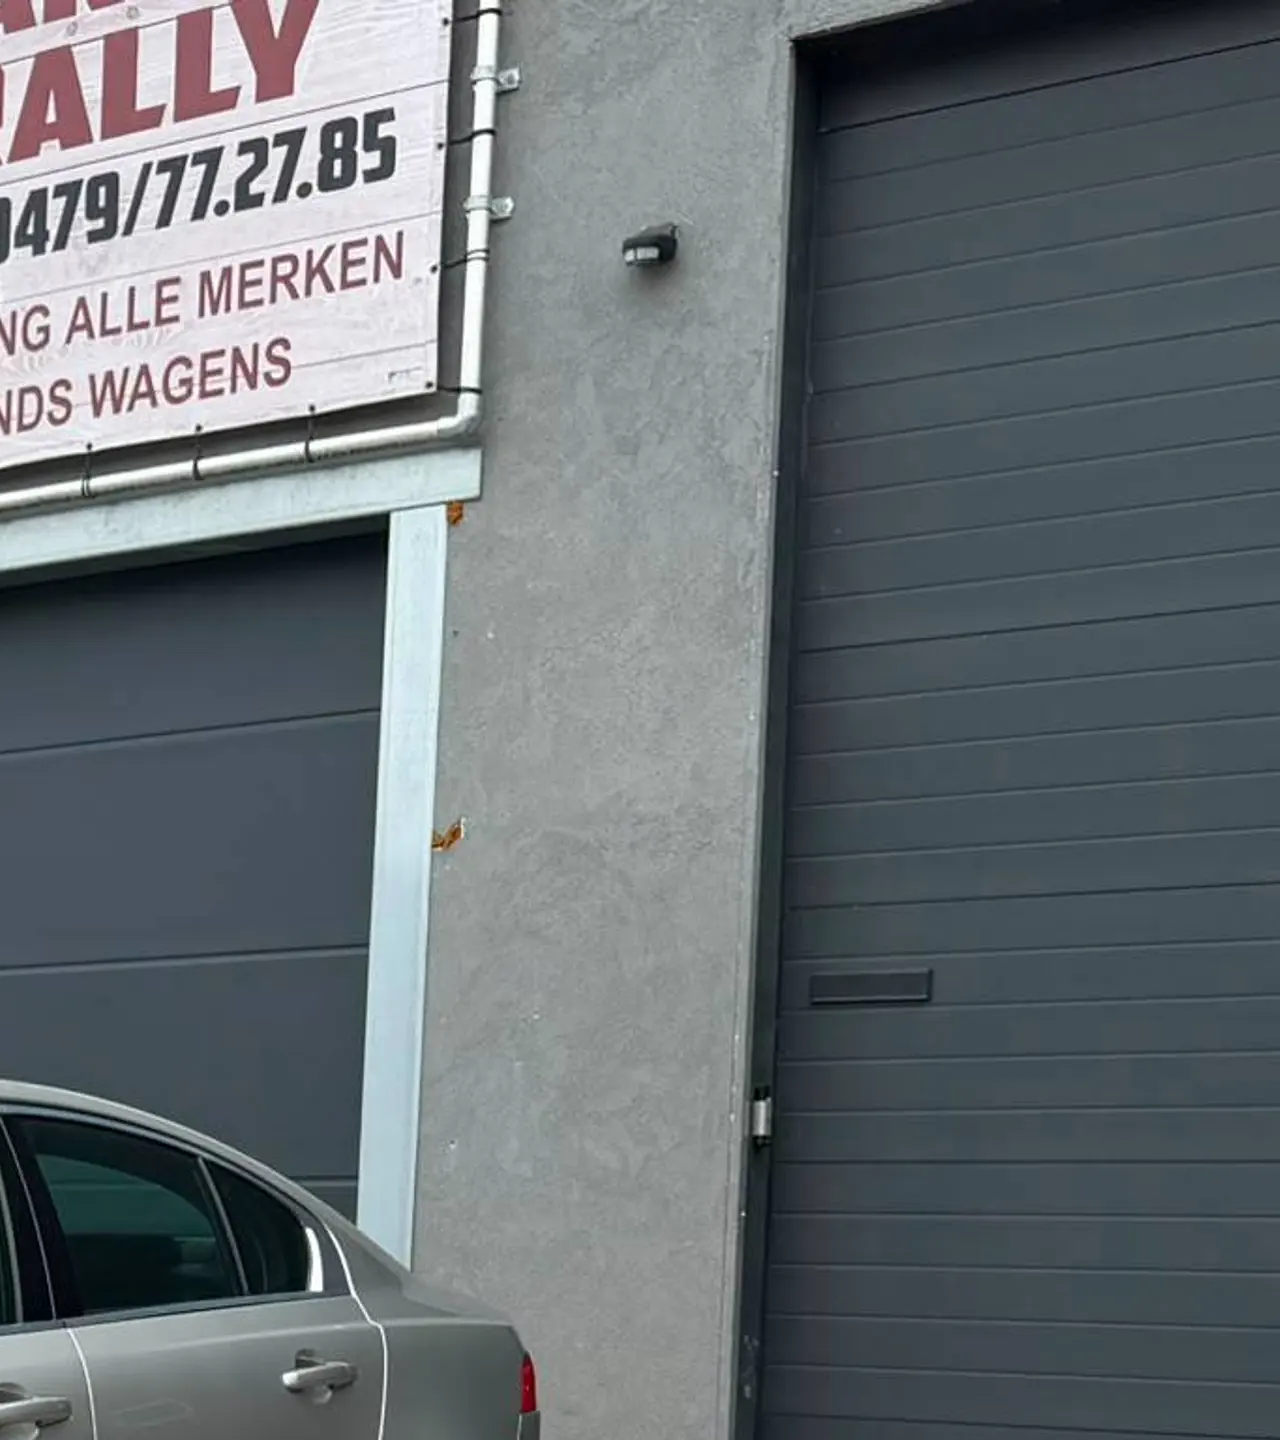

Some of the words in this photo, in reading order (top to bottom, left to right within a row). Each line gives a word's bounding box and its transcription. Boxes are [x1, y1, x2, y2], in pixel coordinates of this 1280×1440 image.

[64, 276, 183, 346] ALLE
[197, 230, 405, 320] MERKEN
[88, 336, 293, 419] WAGENS
